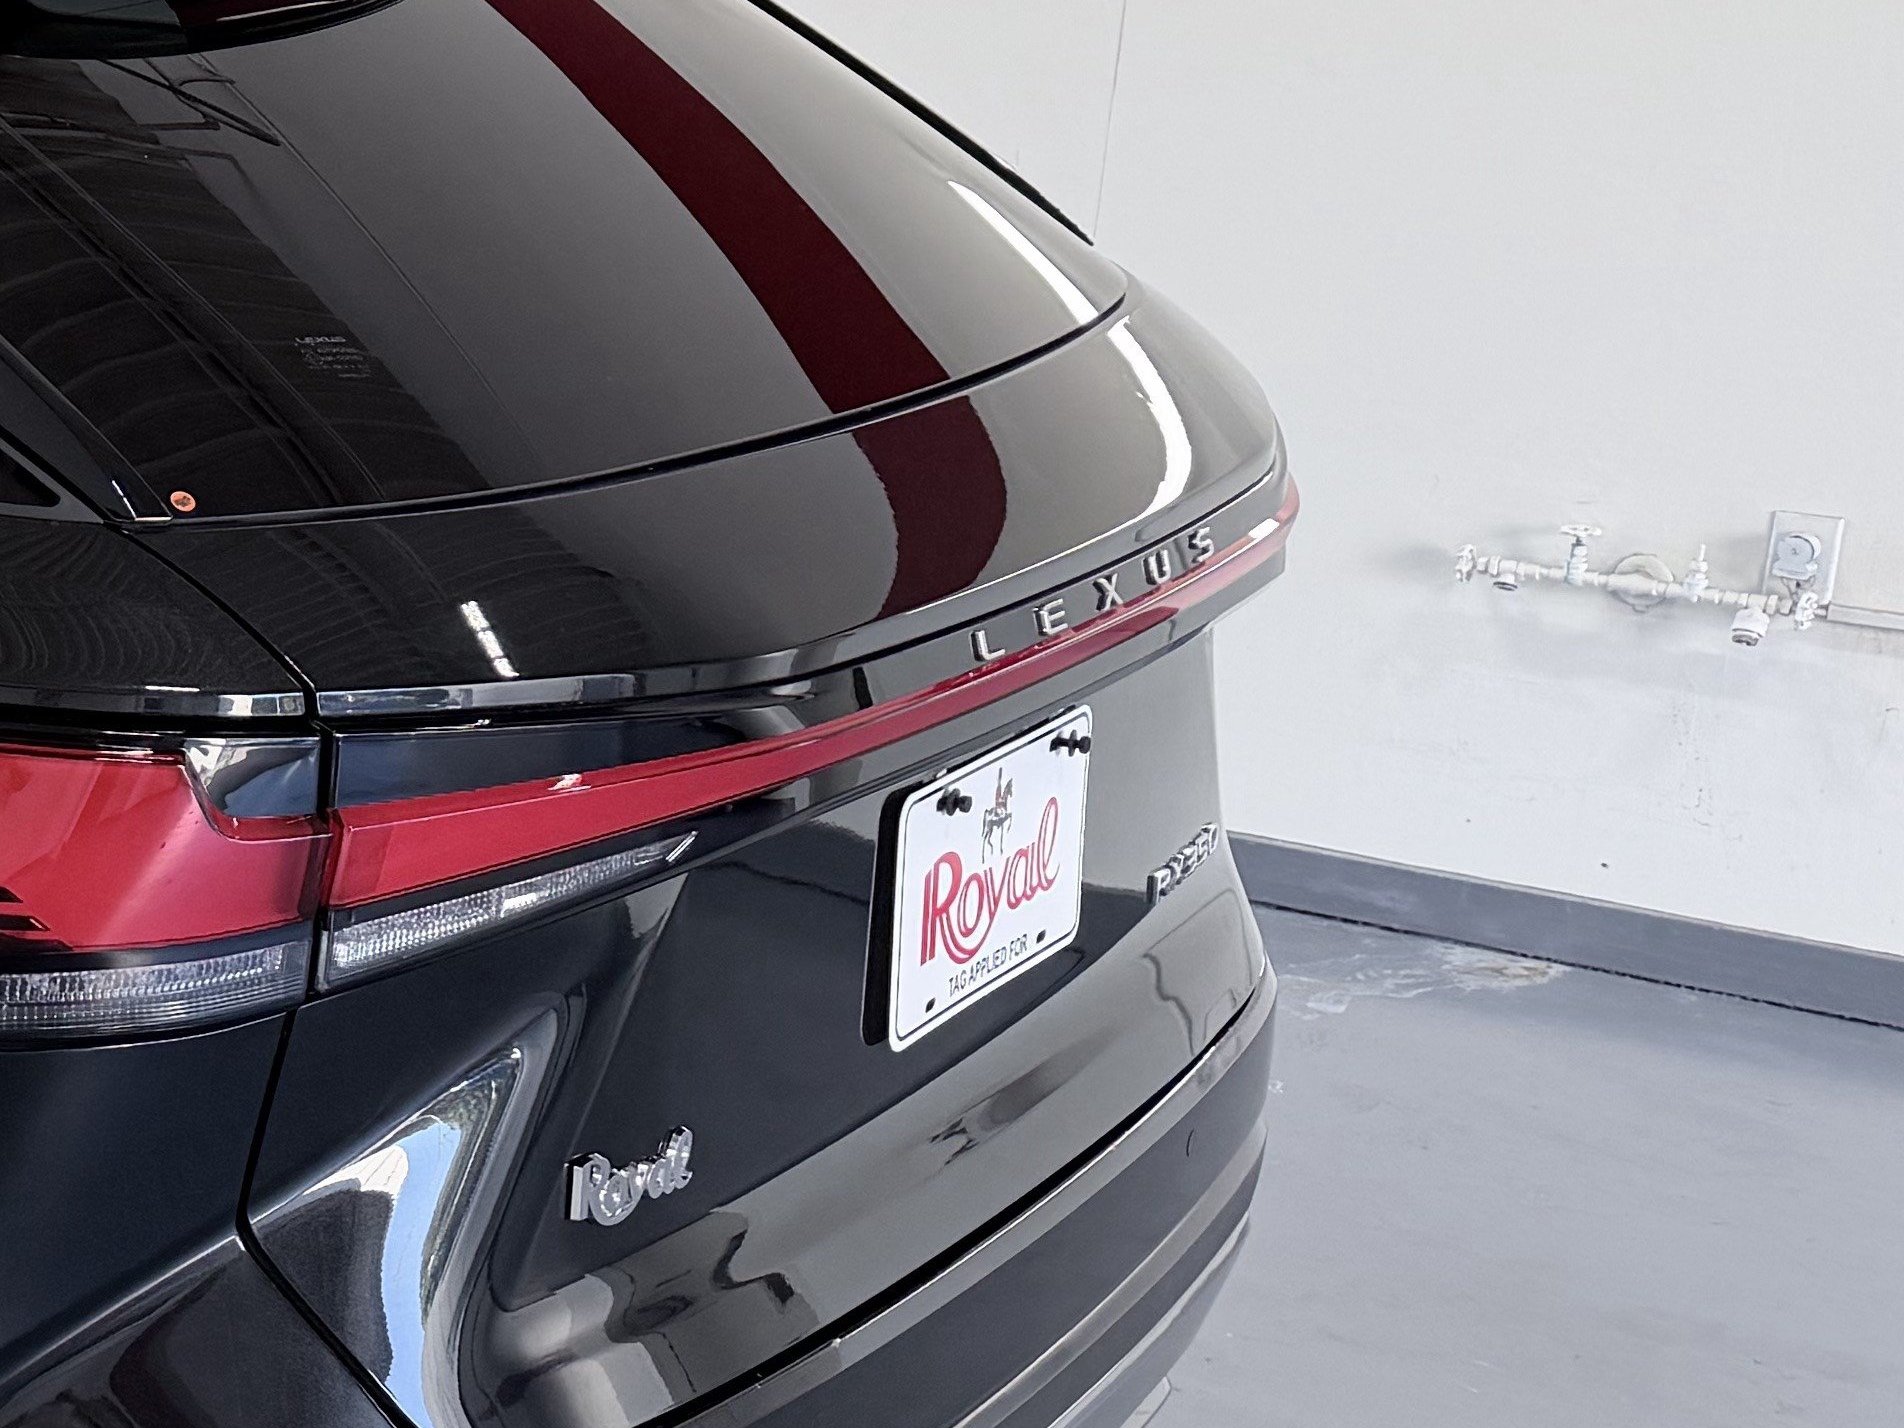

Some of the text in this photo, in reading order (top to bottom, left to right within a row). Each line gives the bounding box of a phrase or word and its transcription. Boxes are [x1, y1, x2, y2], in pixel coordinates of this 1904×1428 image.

[970, 526, 1214, 662] LEXUS
[920, 796, 1061, 967] Royal
[948, 933, 1028, 997] TAG APPLIED FOR
